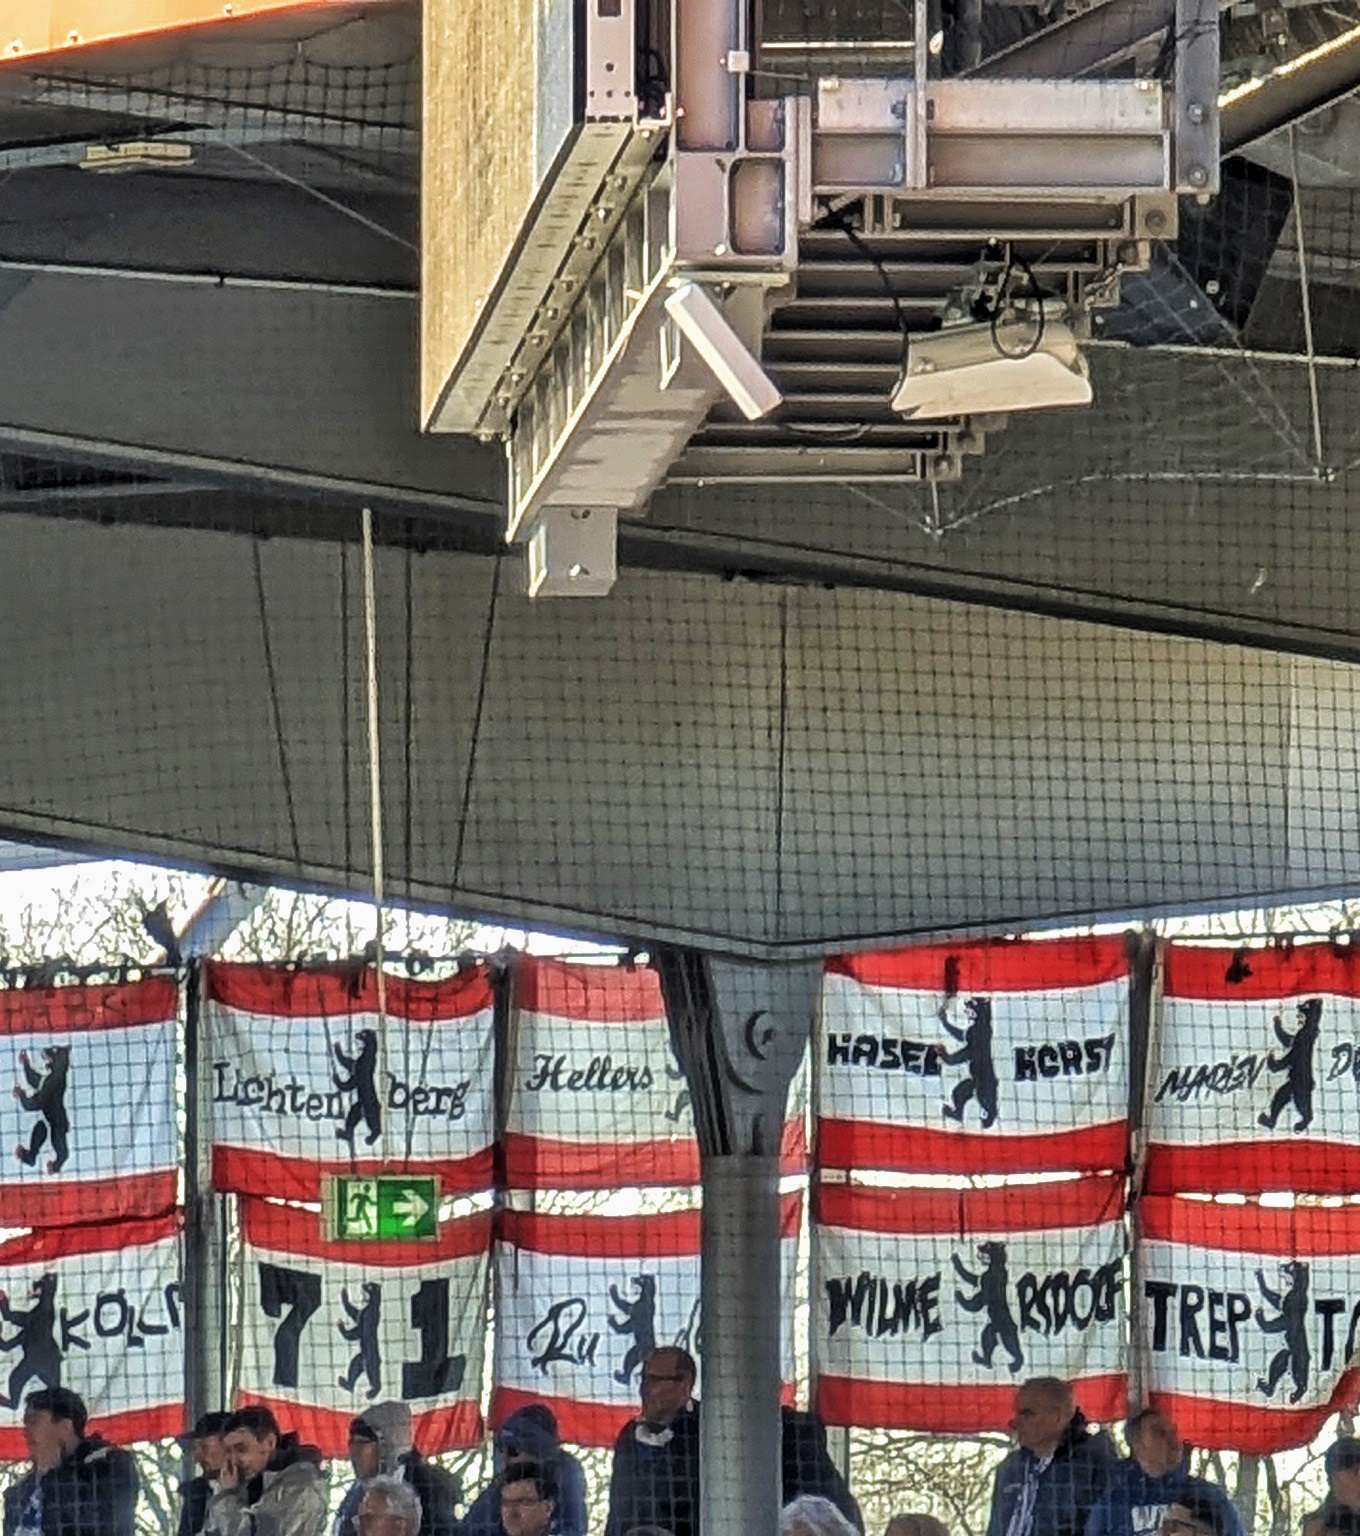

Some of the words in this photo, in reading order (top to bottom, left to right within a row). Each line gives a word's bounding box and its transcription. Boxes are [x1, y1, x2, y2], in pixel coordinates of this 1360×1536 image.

[384, 1070, 470, 1121] berg
[526, 1053, 655, 1093] Hellers
[258, 1261, 322, 1388] 7
[401, 1277, 467, 1400] 1
[1144, 1280, 1252, 1363] TREP
